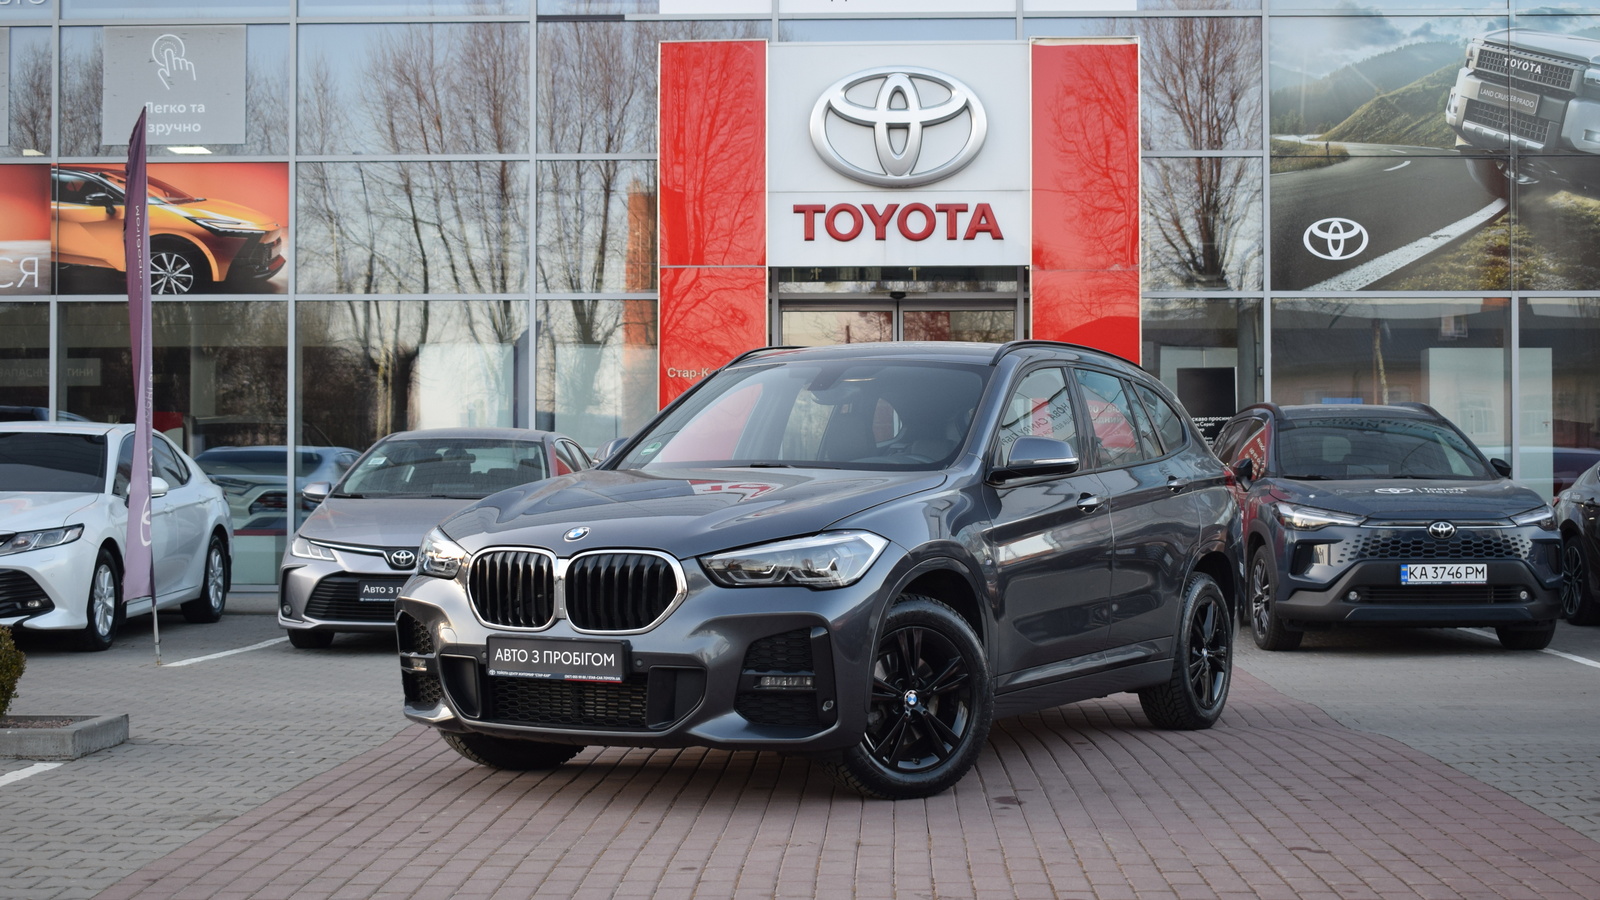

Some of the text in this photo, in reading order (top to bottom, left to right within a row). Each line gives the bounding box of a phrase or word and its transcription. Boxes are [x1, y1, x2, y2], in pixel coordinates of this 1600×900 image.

[1504, 58, 1541, 74] TOYOTA
[1480, 88, 1535, 108] LAND CRUISER PRADO
[145, 102, 206, 114] Легко та
[147, 123, 201, 136] зручно
[793, 203, 1003, 242] TOYOTA
[1432, 566, 1462, 579] 3746
[494, 648, 529, 663] АВТО
[543, 650, 615, 667] ПРОБІГОМ
